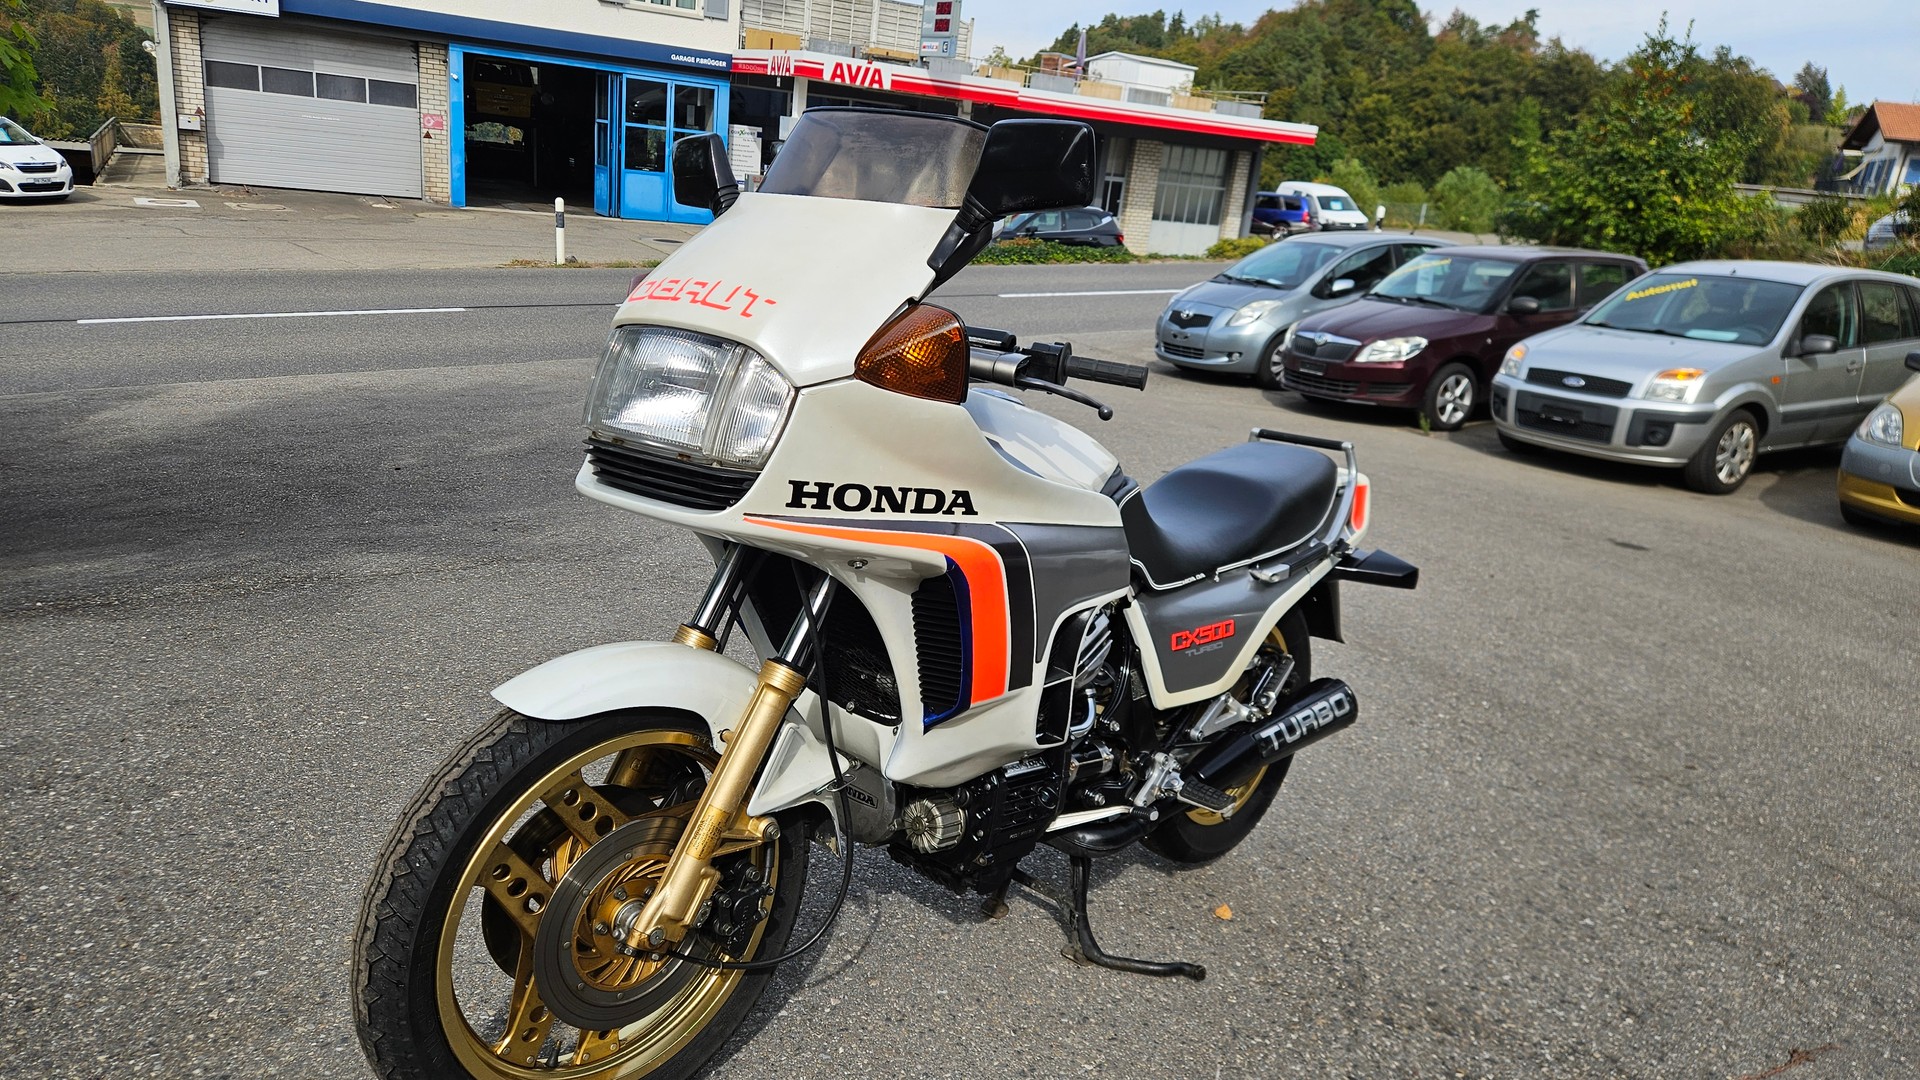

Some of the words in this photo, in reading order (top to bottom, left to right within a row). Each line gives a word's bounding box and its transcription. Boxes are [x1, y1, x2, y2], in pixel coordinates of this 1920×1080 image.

[671, 54, 695, 63] GARAGE
[770, 50, 791, 76] AVIA
[830, 60, 884, 89] AVIA
[1625, 278, 1699, 302] Automat
[785, 480, 979, 516] HONDA
[1172, 619, 1235, 651] CX500
[1185, 642, 1223, 657] TURBO
[1260, 693, 1351, 751] TURBO
[848, 787, 875, 806] NDA
